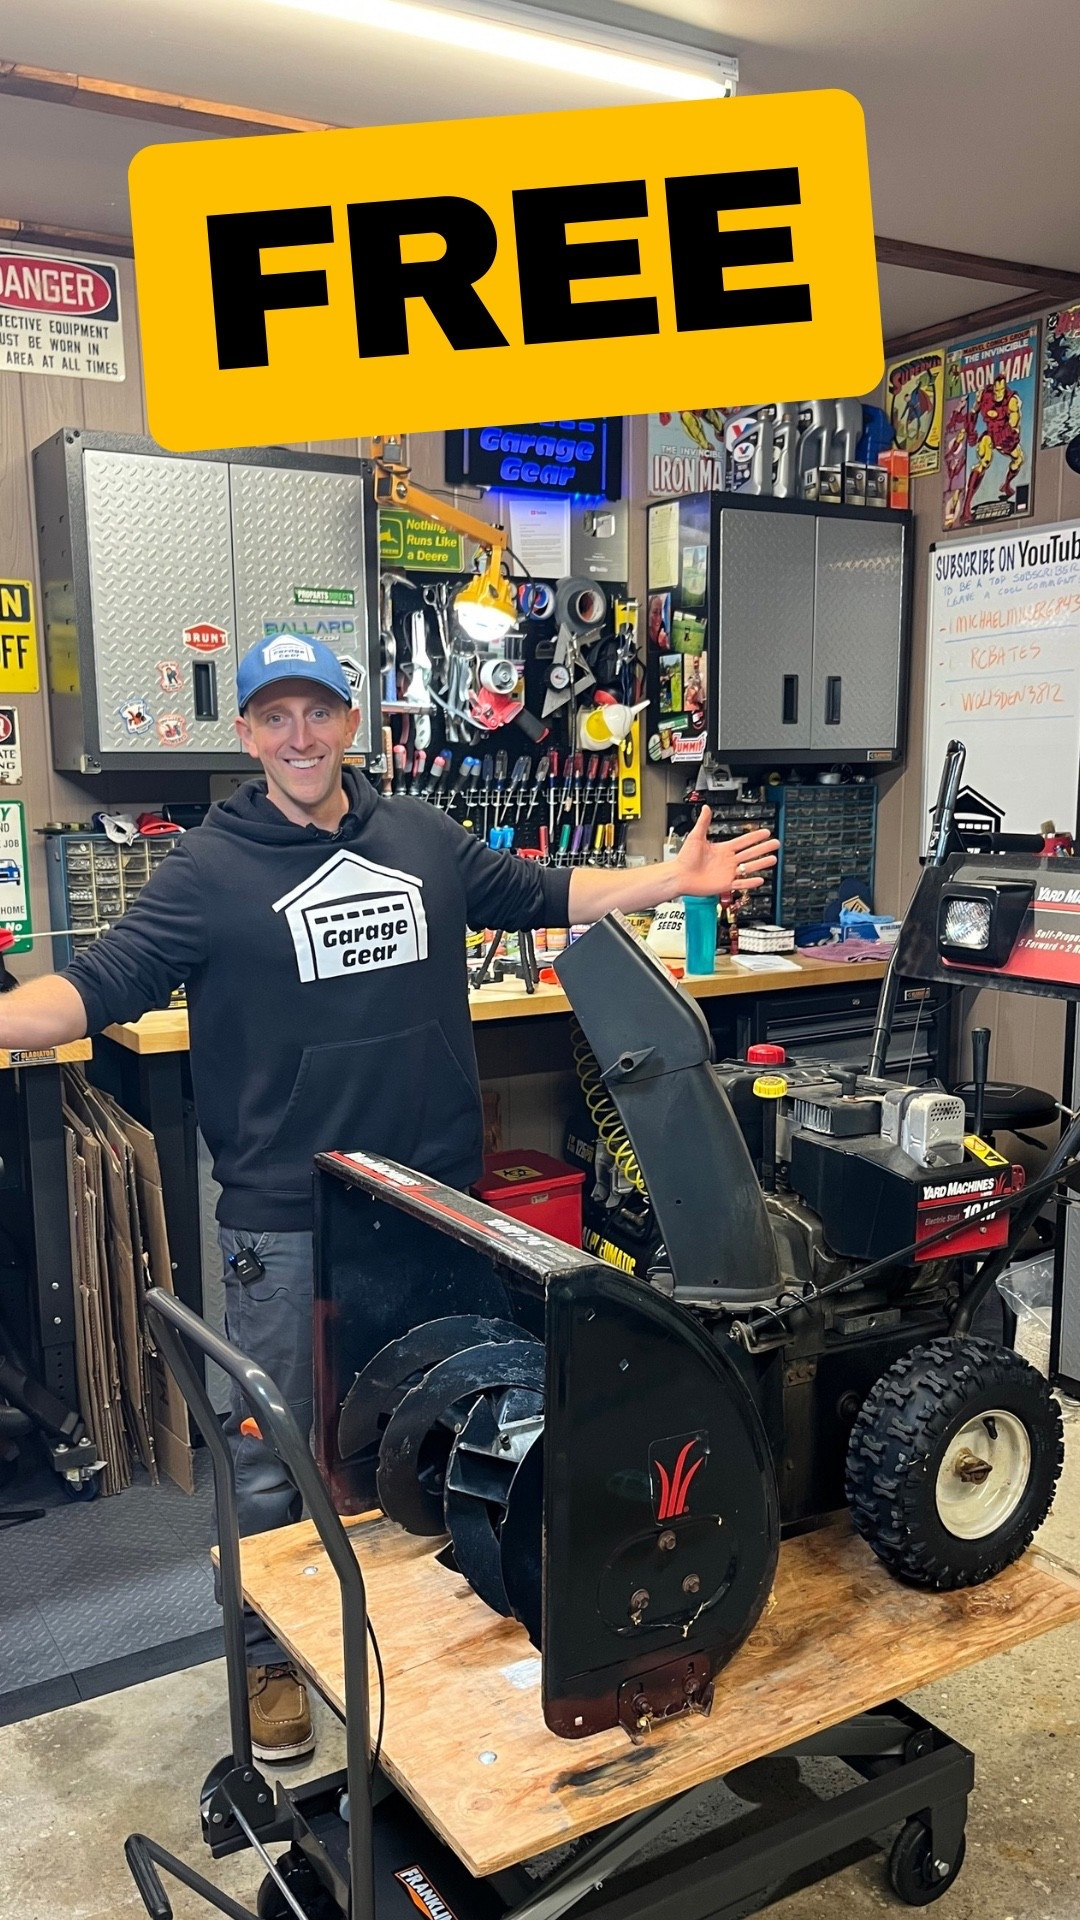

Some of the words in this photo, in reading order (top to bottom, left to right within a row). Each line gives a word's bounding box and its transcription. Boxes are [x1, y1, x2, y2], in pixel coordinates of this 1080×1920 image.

[49, 319, 109, 340] EQUIPMENT
[28, 335, 42, 349] BE
[50, 338, 81, 353] WORN
[88, 342, 99, 355] IN
[964, 352, 979, 364] THE
[981, 338, 1029, 358] INVINCIBLE
[6, 351, 35, 367] AREA
[42, 355, 54, 369] AT
[61, 357, 81, 372] ALL
[86, 359, 118, 375] TIMES
[960, 362, 994, 395] IRON
[999, 352, 1033, 384] MAN
[479, 427, 596, 463] Garage
[661, 445, 678, 455] THE
[500, 457, 577, 486] Gear
[653, 454, 697, 493] IRON
[406, 519, 447, 534] Nothing
[406, 534, 433, 547] Runs
[435, 535, 457, 548] Like
[407, 551, 414, 560] a
[416, 550, 448, 562] Deere
[935, 547, 996, 581] SUBSCRIBE
[999, 544, 1015, 572] ON
[959, 581, 971, 592] BE
[976, 578, 982, 588] A
[989, 576, 1006, 586] TOP
[1, 588, 22, 617] N
[946, 593, 975, 608] LEAVE
[984, 591, 991, 599] A
[264, 620, 354, 636] BALLARD
[184, 633, 227, 643] BRUNT
[4, 840, 20, 848] JOB
[1037, 887, 1065, 903] YARD
[1, 906, 25, 915] HOME
[5, 923, 22, 931] No
[628, 919, 645, 927] LIP
[656, 922, 682, 931] SEEDS
[323, 919, 408, 948] Garage
[1018, 939, 1026, 947] 5
[1025, 940, 1059, 951] Forward
[1065, 944, 1072, 953] 2
[342, 944, 397, 967] Gear
[923, 1185, 947, 1200] YARD
[947, 1178, 995, 1197] MACHINES
[925, 1215, 946, 1226] Electric
[947, 1213, 960, 1222] Start
